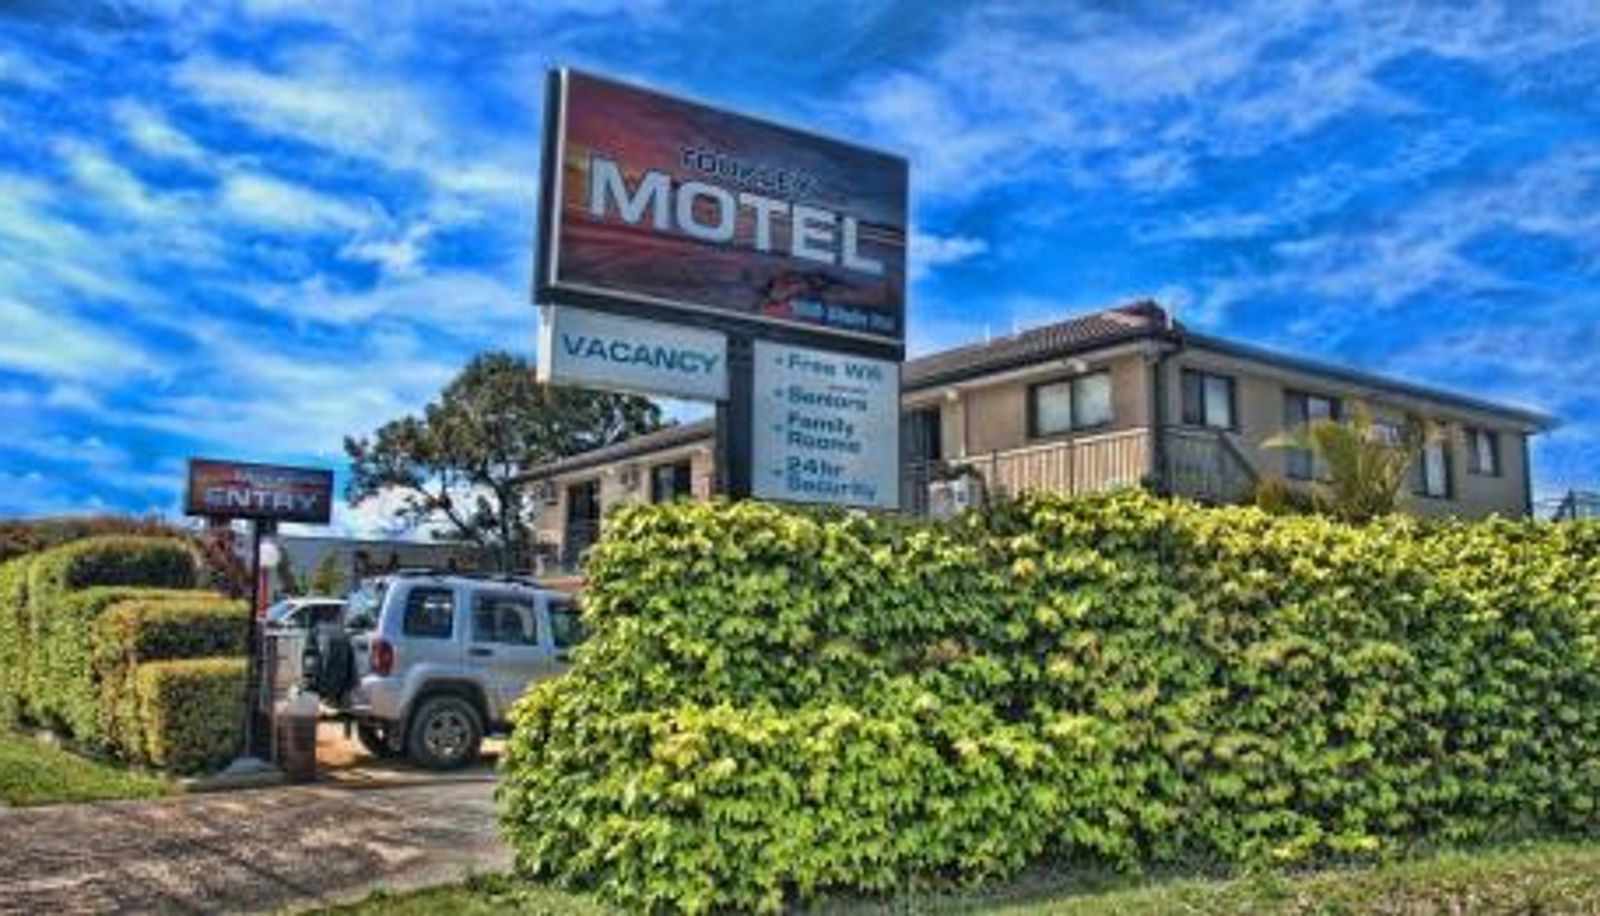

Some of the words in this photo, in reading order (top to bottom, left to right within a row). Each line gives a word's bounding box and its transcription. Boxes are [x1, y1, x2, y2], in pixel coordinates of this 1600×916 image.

[588, 155, 885, 275] MOTEL
[562, 333, 719, 373] VACANCY
[787, 353, 836, 377] Free
[787, 411, 854, 439] Family
[786, 430, 862, 454] Rooms
[204, 486, 318, 511] ENTRY
